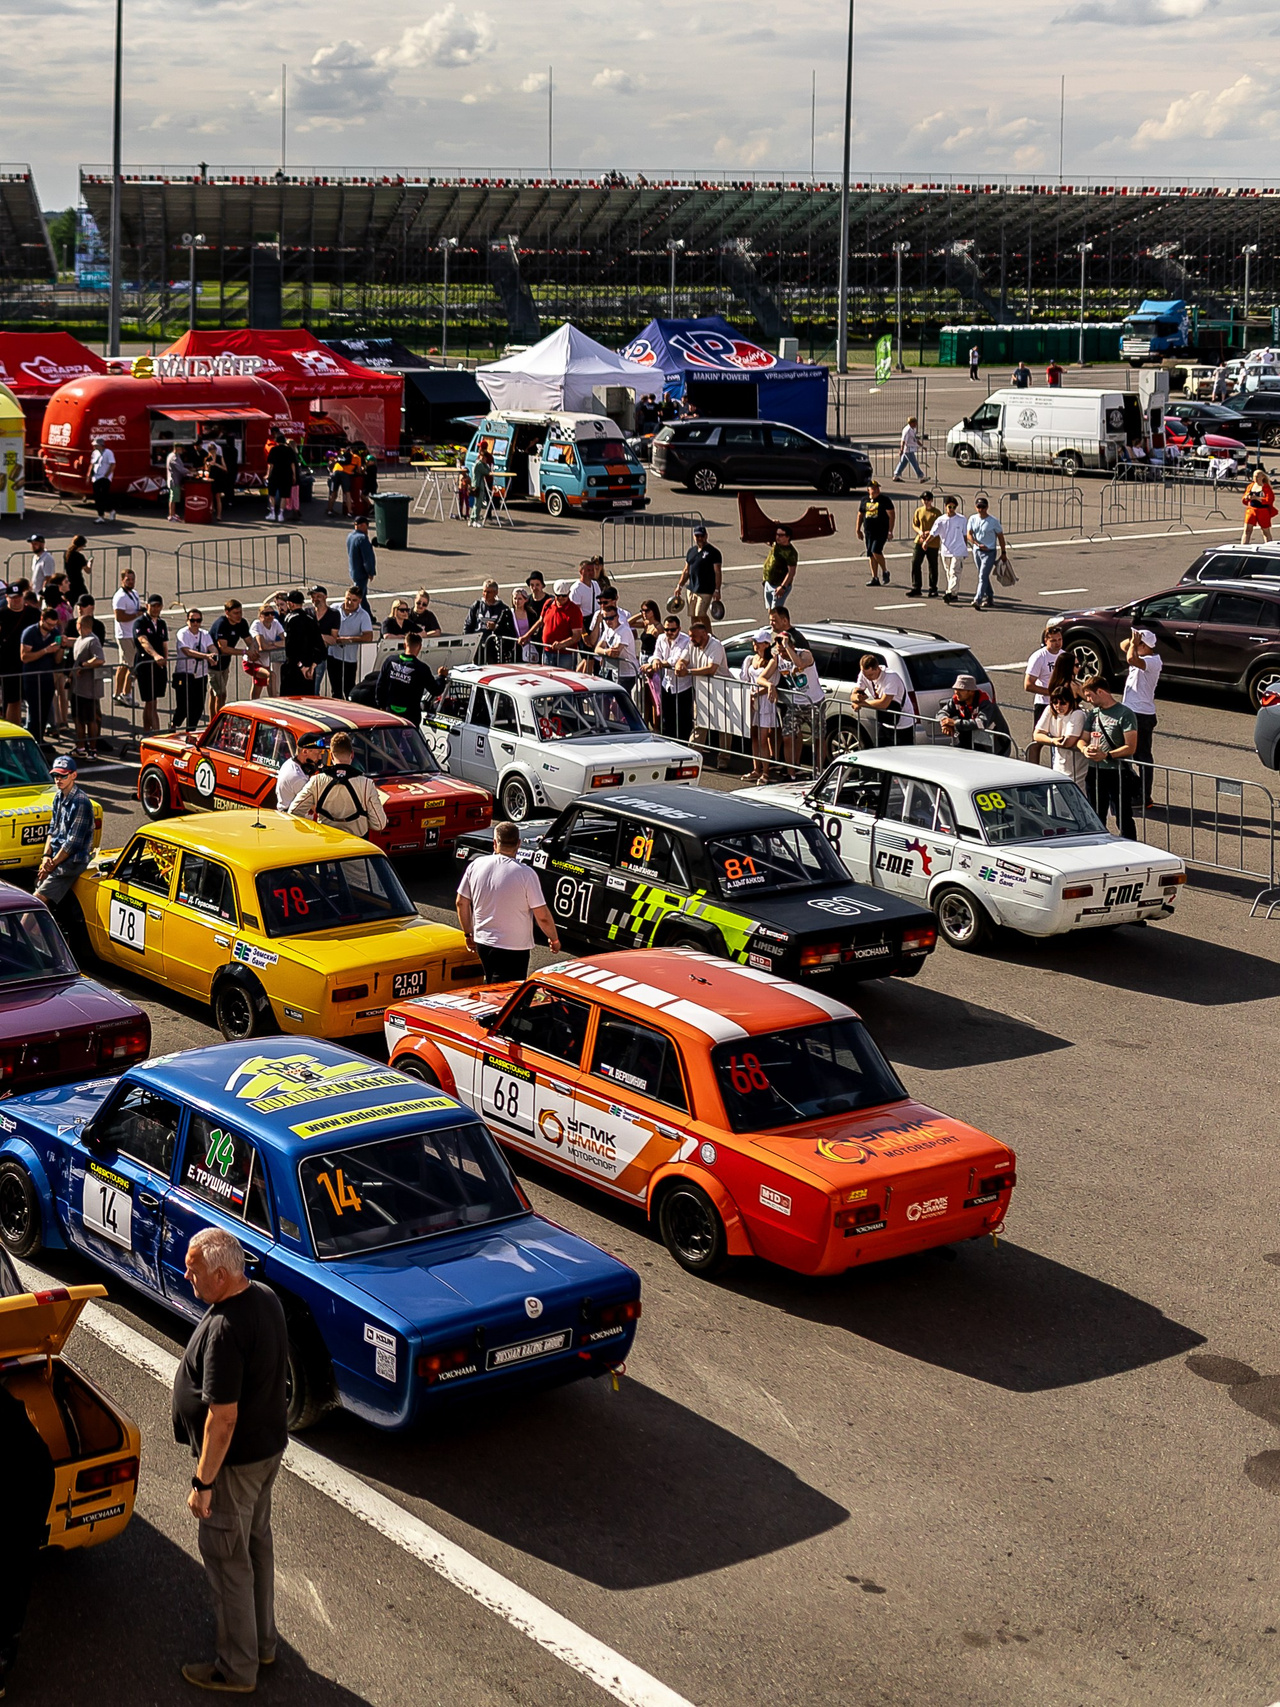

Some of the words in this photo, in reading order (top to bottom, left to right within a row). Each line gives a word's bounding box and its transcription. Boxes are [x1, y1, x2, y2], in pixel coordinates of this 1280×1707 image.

[39, 364, 93, 374] GRAPPA
[732, 350, 767, 366] Racing
[539, 717, 566, 739] 82
[199, 768, 212, 791] 21
[398, 782, 437, 795] 21
[604, 795, 696, 820] LIMENS
[976, 791, 1007, 812] 98
[535, 853, 547, 865] 81
[630, 835, 654, 862] 81
[724, 856, 757, 880] 81
[875, 850, 914, 877] CME
[727, 876, 766, 889] А.ЦЫГАНКОВ
[998, 878, 1014, 888] банк
[999, 871, 1028, 884] Земский
[273, 886, 310, 918] 78
[554, 876, 593, 924] 81
[807, 895, 884, 916] 81
[1104, 882, 1144, 906] CME
[119, 908, 136, 941] 78
[252, 948, 278, 962] Земский
[753, 939, 784, 956] LIMENS
[854, 945, 890, 959] YOKOHAMA
[251, 957, 266, 968] банк
[395, 972, 424, 989] 21-01
[399, 986, 420, 996] ДАН
[488, 1055, 531, 1078] CLASSICTOURING
[729, 1053, 770, 1095] 68
[494, 1075, 520, 1119] 68
[305, 1098, 446, 1134] www.podolskkabel.ru
[567, 1116, 617, 1148] УГМК
[853, 1119, 935, 1143] УГМК
[873, 1126, 950, 1151] UMMC
[204, 1127, 235, 1178] 14
[567, 1131, 617, 1161] UMMC
[882, 1135, 960, 1158] MOTORSPORT
[567, 1146, 617, 1174] МОТОРСПОРТ
[91, 1161, 130, 1189] CLASSICTOURING
[316, 1169, 363, 1216] 14
[762, 1188, 781, 1203] M1D
[99, 1185, 119, 1234] 14
[856, 1222, 885, 1235] YOKOHAMA
[589, 1325, 623, 1341] YOKOHAMA
[438, 1365, 477, 1381] YOKOHAMA
[82, 1507, 121, 1523] YOKOHAMA
